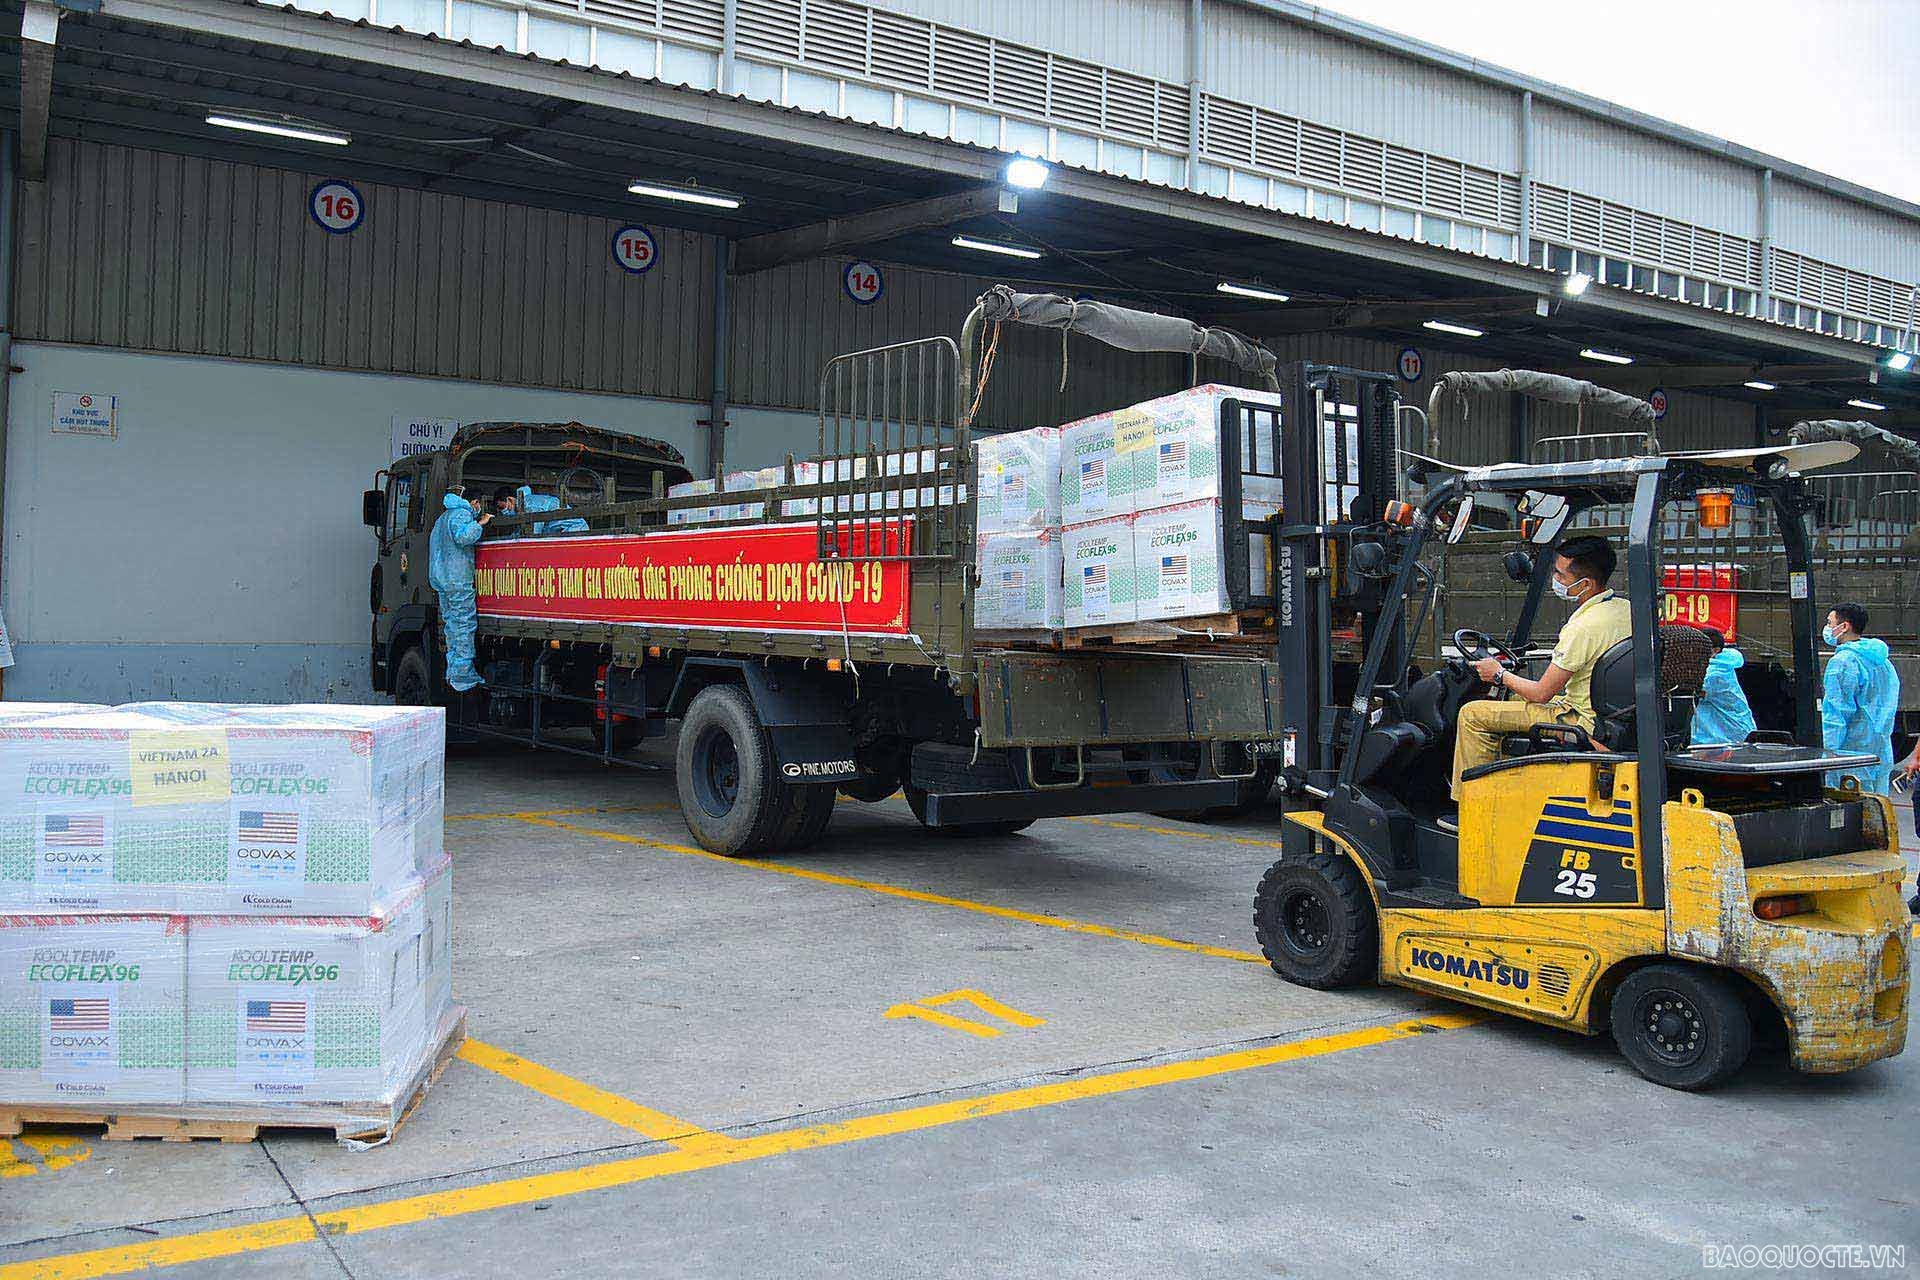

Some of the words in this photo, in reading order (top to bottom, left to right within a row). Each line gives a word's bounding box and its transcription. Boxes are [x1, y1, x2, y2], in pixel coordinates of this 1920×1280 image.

[321, 195, 354, 220] 16
[621, 238, 649, 260] 15
[852, 272, 877, 292] 14
[1404, 357, 1419, 373] 11
[409, 422, 430, 438] CHÚ
[433, 421, 443, 438] Ý!
[1160, 463, 1186, 473] COVAX
[1151, 530, 1198, 548] ECOFLEX96
[1077, 543, 1117, 560] ECOFLEX96
[518, 561, 536, 597] TÍCH
[538, 564, 556, 605] CỰC
[558, 566, 584, 599] THAM
[586, 567, 601, 600] GIA
[604, 552, 641, 601] HƯỞNG
[669, 556, 712, 601] PHÒNG
[715, 550, 763, 602] CHỐNG
[766, 562, 802, 611] DỊCH
[1162, 578, 1187, 586] COVAX
[1281, 546, 1292, 627] KOMATSU
[139, 749, 198, 763] VIETNAM
[154, 769, 206, 787] HANOI
[231, 763, 304, 776] OOLTEMP
[24, 776, 132, 798] ECOFLEX96
[231, 777, 329, 797] COFLEX96
[45, 852, 103, 863] COVAX
[237, 848, 297, 860] COVAX
[1559, 849, 1591, 871] FB
[1553, 869, 1597, 899] 25
[33, 949, 116, 963] KOOLTEMP
[231, 949, 314, 963] KOOLTEMP
[29, 963, 140, 983] ECOFLEX96
[228, 961, 339, 985] ECOFLEX96
[1411, 947, 1530, 990] KOMATSU
[50, 1036, 110, 1047] COVAX
[246, 1038, 306, 1049] COVAX
